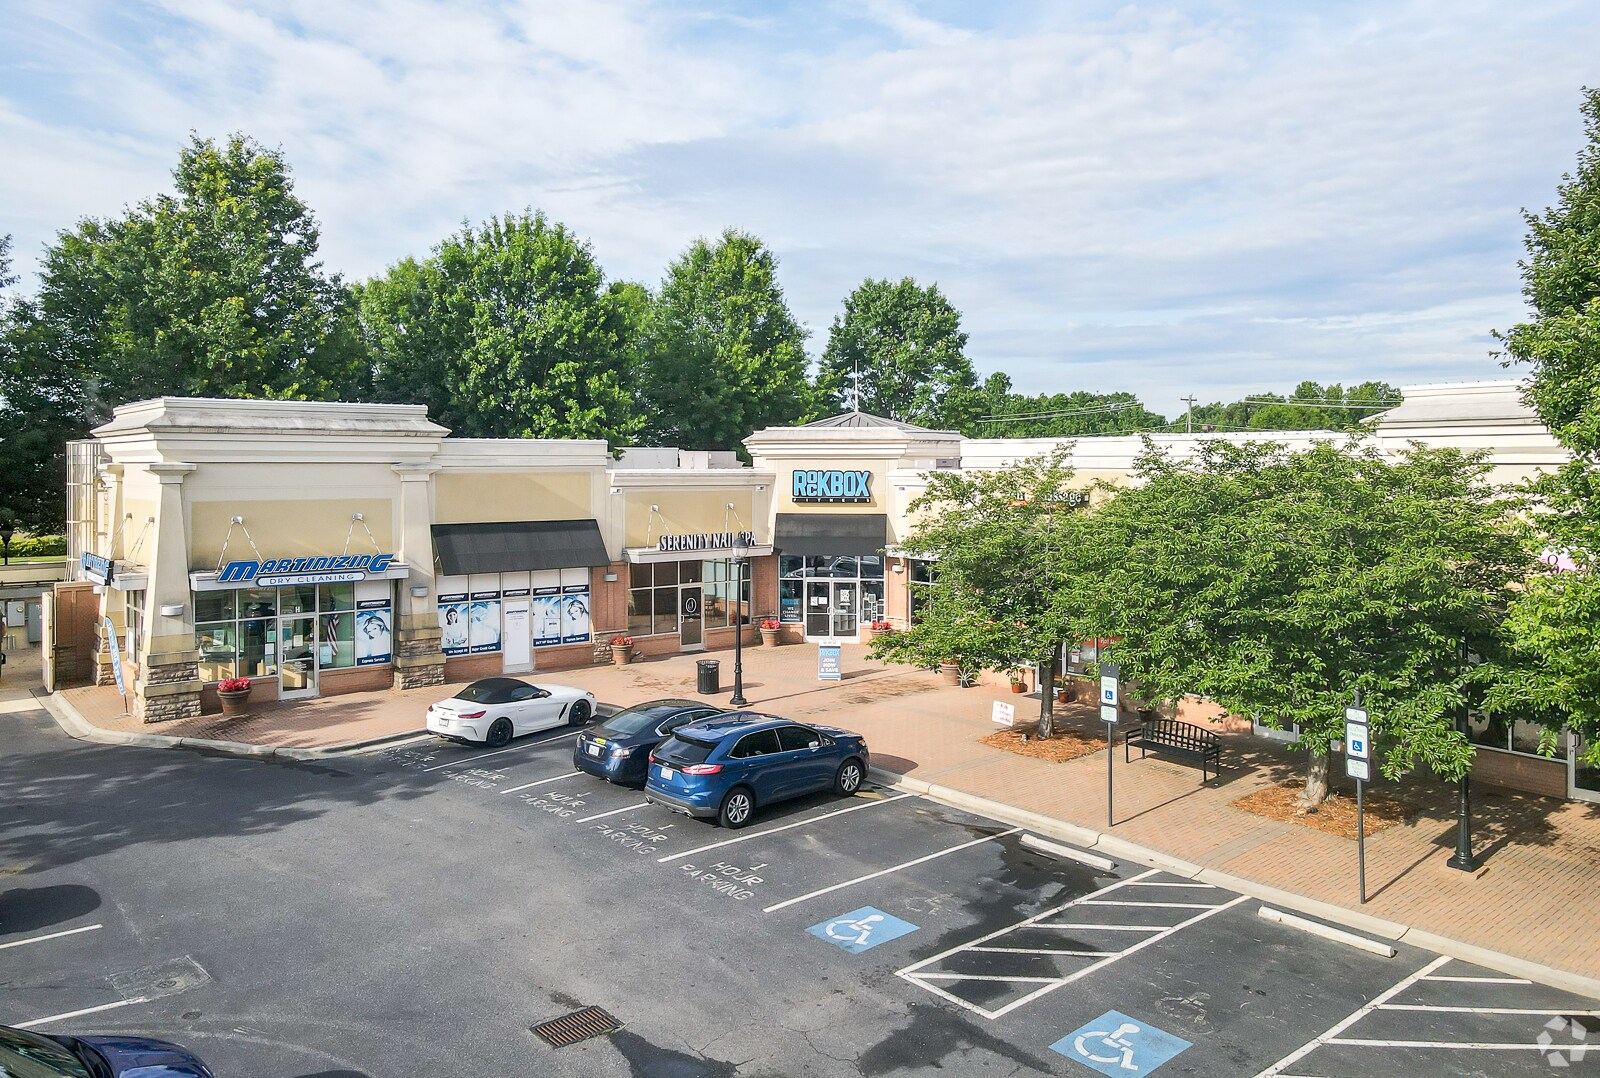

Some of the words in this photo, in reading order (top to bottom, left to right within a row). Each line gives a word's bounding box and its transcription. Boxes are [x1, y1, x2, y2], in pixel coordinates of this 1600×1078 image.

[659, 533, 708, 551] SERENITY
[217, 554, 394, 582] MARTINIZING
[269, 577, 291, 585] DRY
[297, 574, 354, 583] CLEANING
[517, 793, 577, 817] PARKING
[620, 822, 668, 843] HOUR
[657, 823, 675, 831] 1
[588, 823, 657, 855] PARKING
[708, 861, 765, 886] HOUR
[749, 863, 769, 871] 1
[679, 863, 756, 901] PARKING
